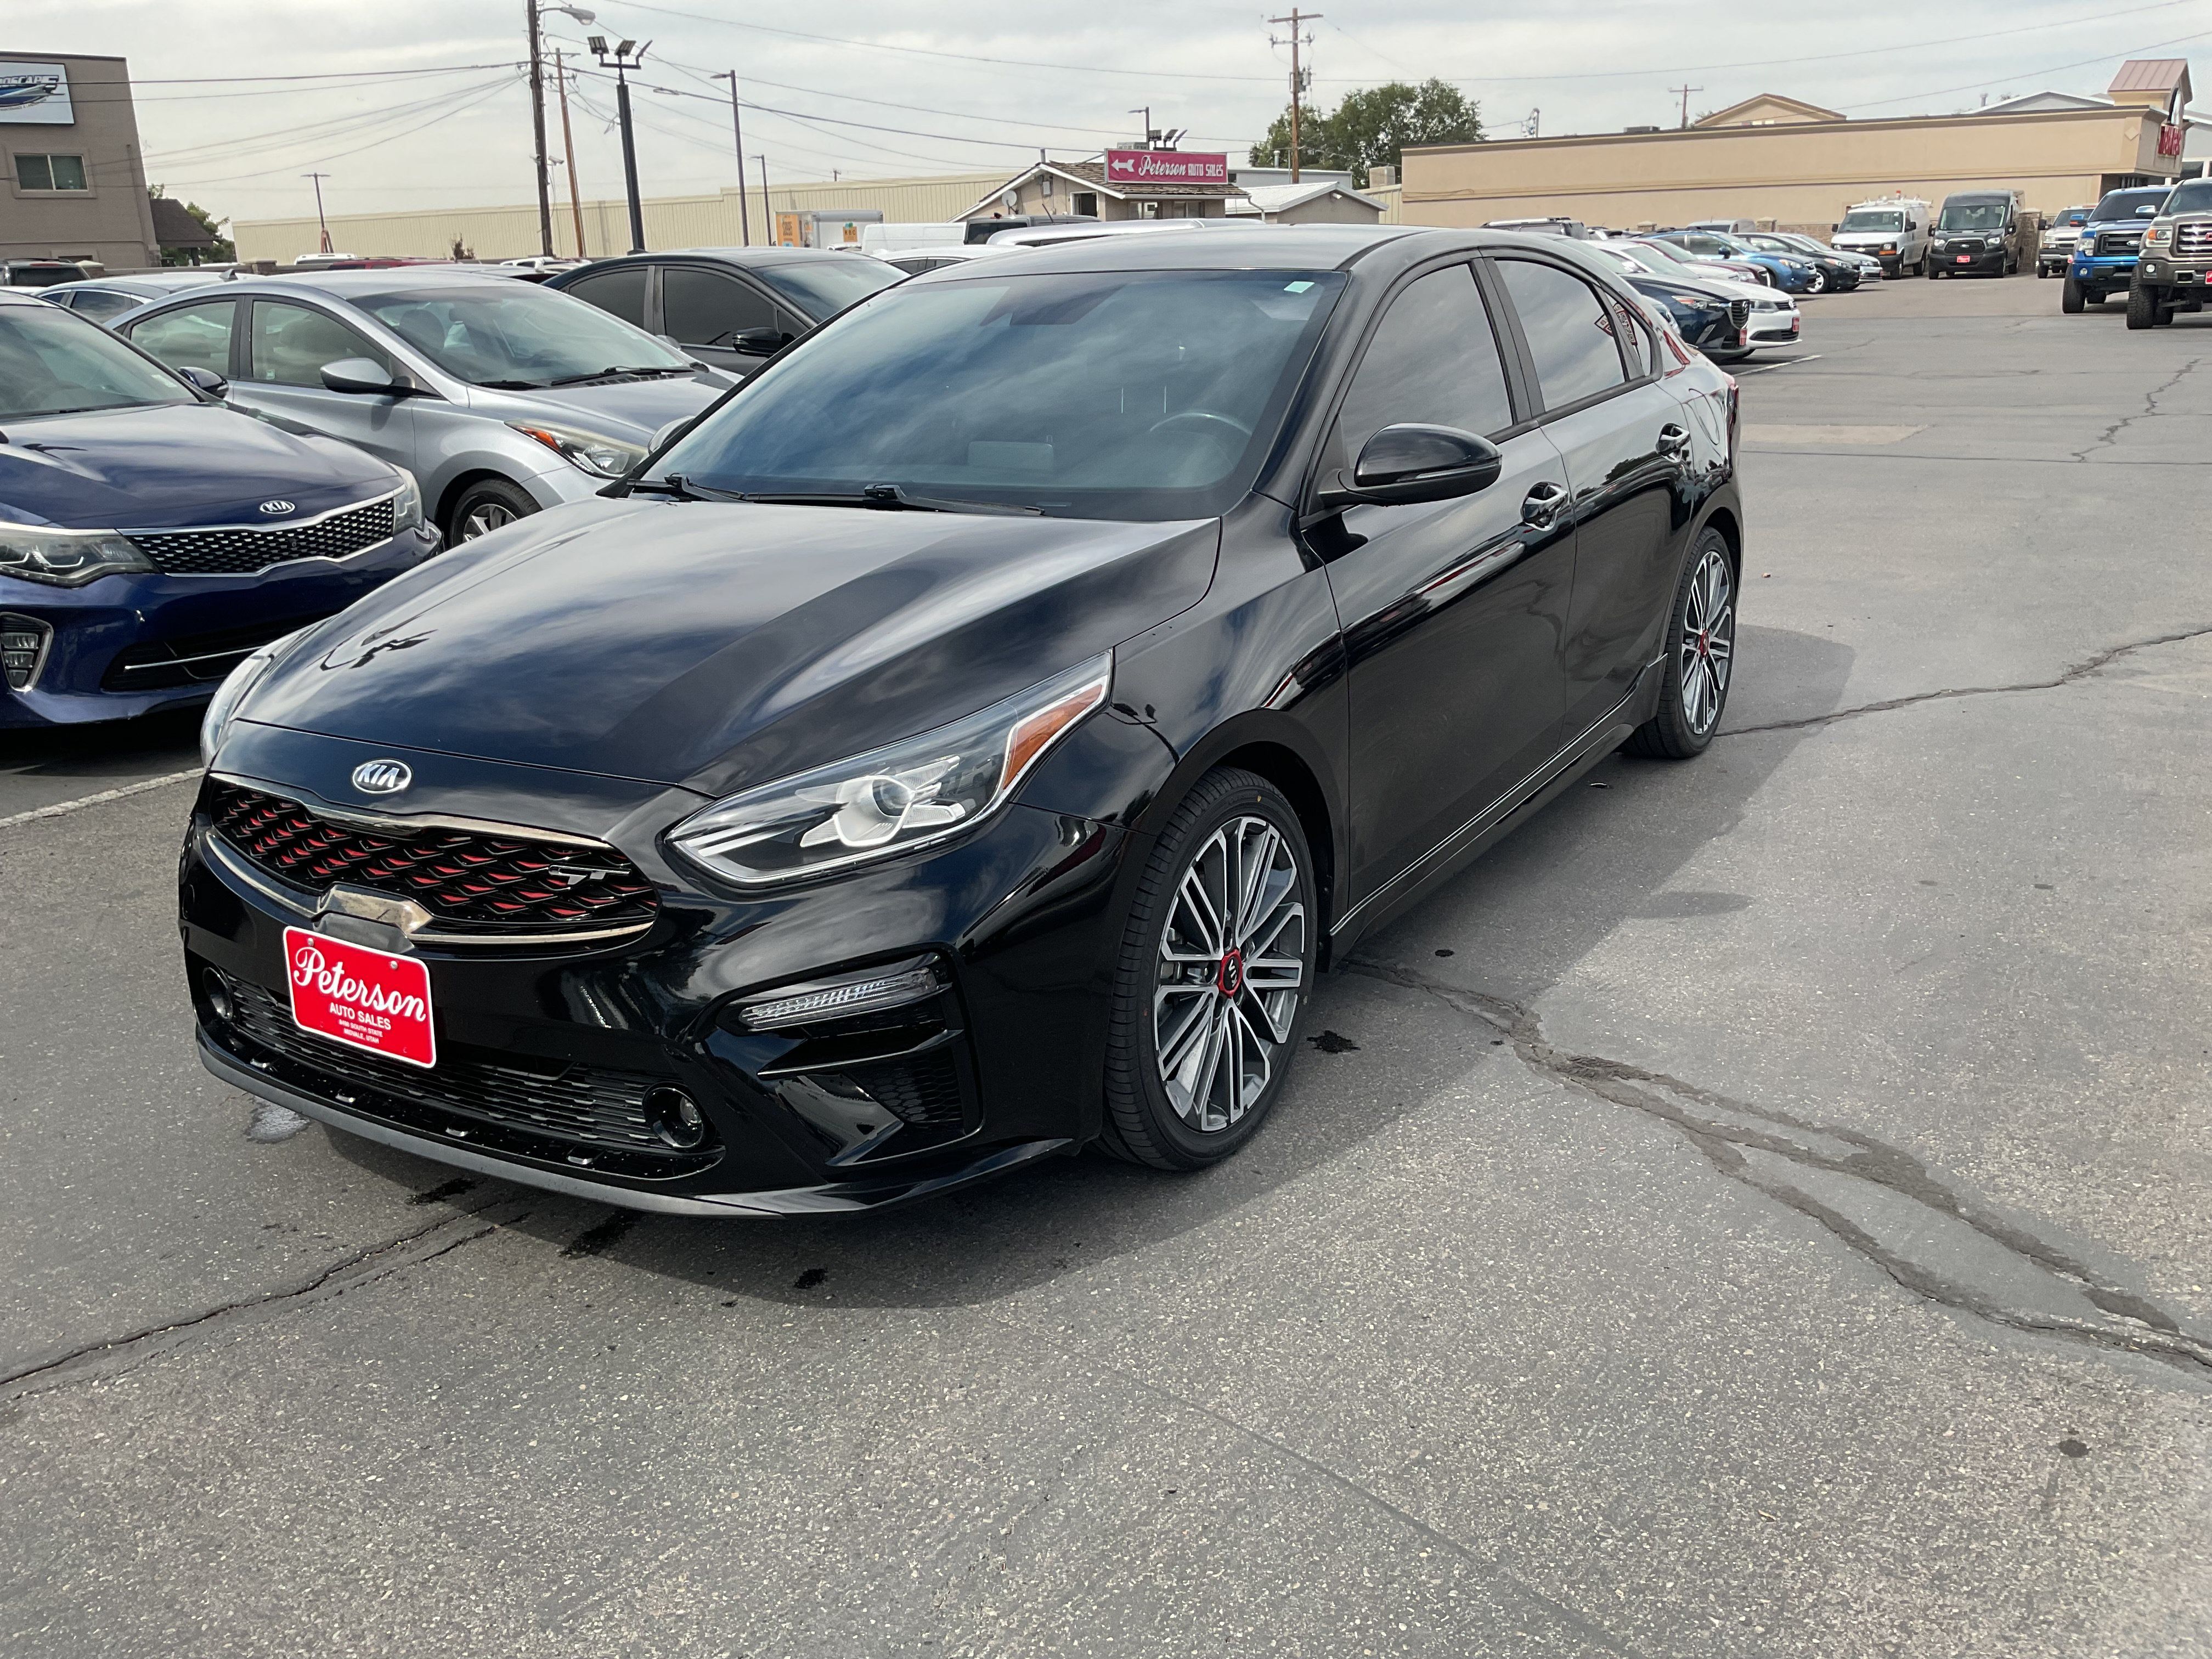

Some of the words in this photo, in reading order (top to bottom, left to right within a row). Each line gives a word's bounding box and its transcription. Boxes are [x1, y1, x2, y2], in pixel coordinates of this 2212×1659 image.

[1138, 155, 1187, 176] Peterson
[1188, 163, 1204, 176] AUTO
[1206, 164, 1223, 177] SALES
[264, 501, 291, 511] KIA
[357, 764, 400, 787] KIA
[549, 865, 630, 885] GT
[294, 946, 426, 1022] Peterson
[1228, 959, 1238, 988] KIA
[330, 1002, 356, 1019] AUTO
[358, 1011, 391, 1030] SALES
[351, 1022, 367, 1032] SOUTH
[368, 1028, 383, 1037] STATE
[366, 1035, 380, 1043] UTAH
